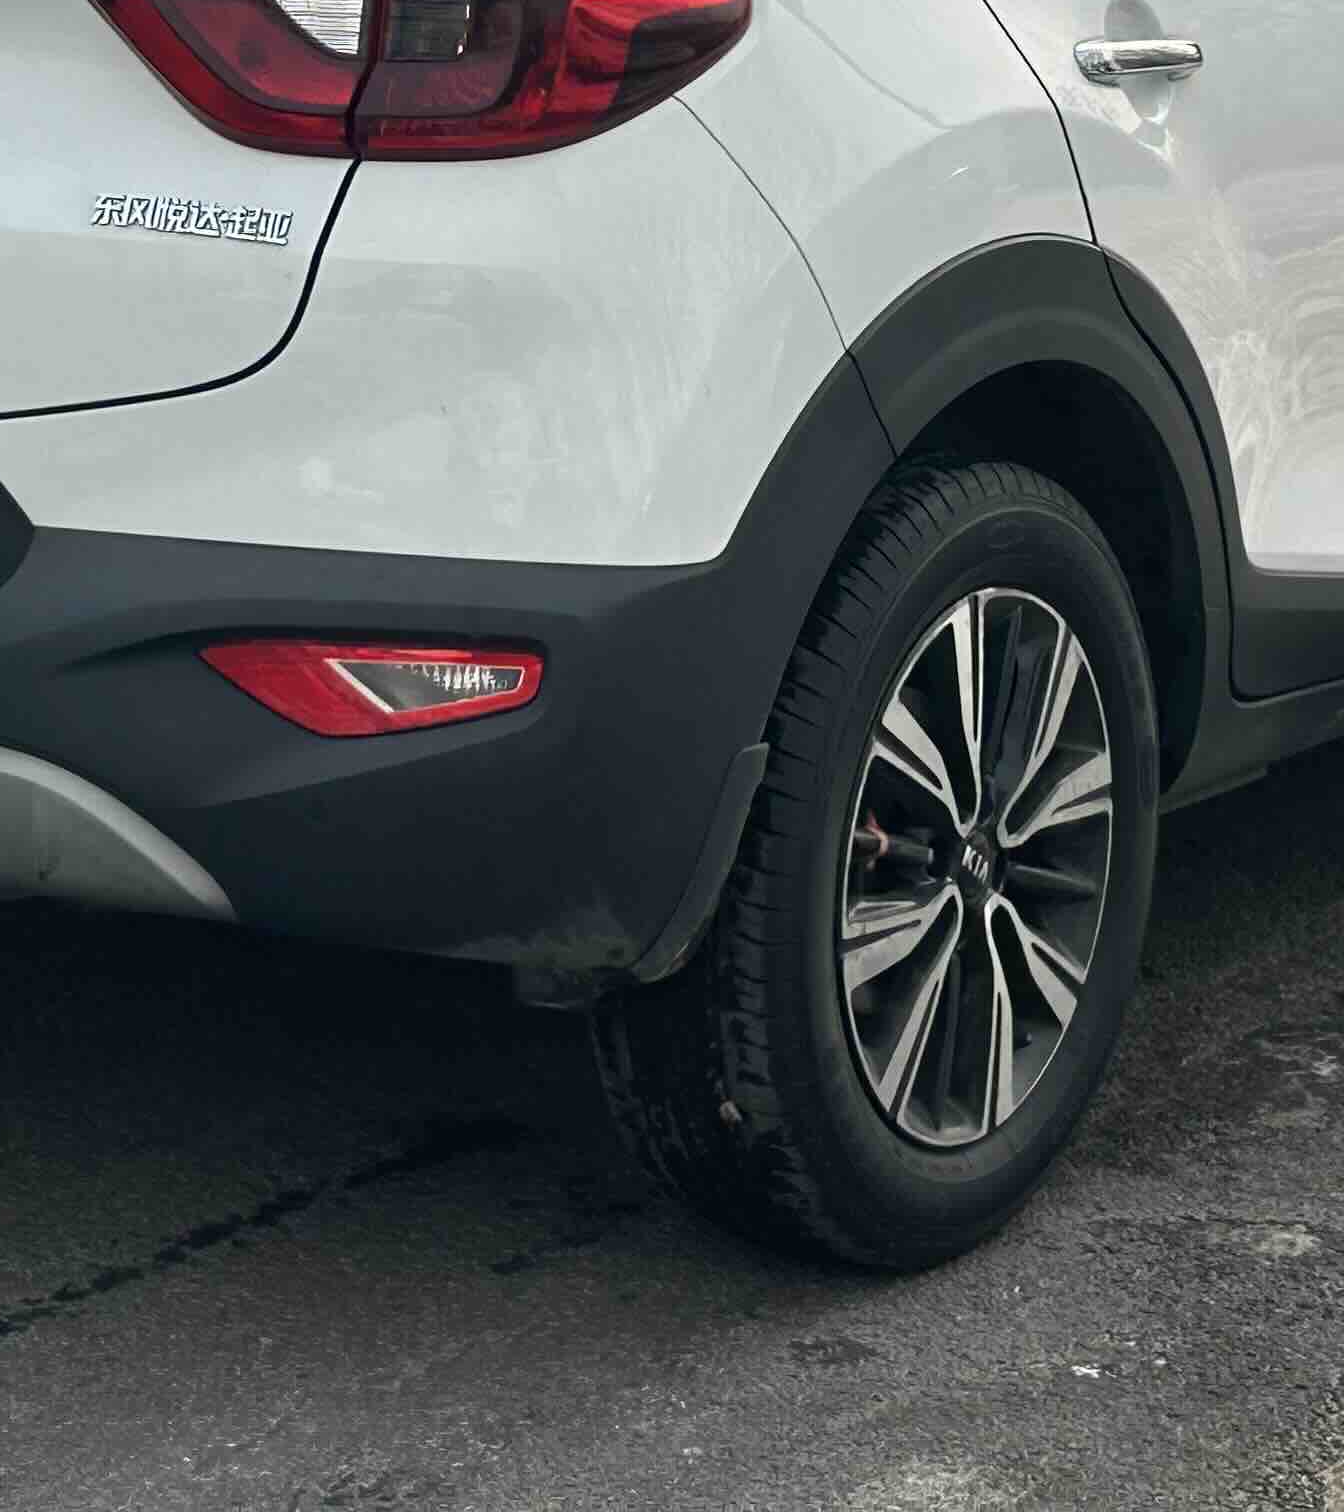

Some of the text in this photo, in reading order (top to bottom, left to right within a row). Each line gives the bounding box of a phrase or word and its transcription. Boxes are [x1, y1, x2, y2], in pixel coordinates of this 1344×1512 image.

[91, 192, 294, 246] 东风悦达起亚
